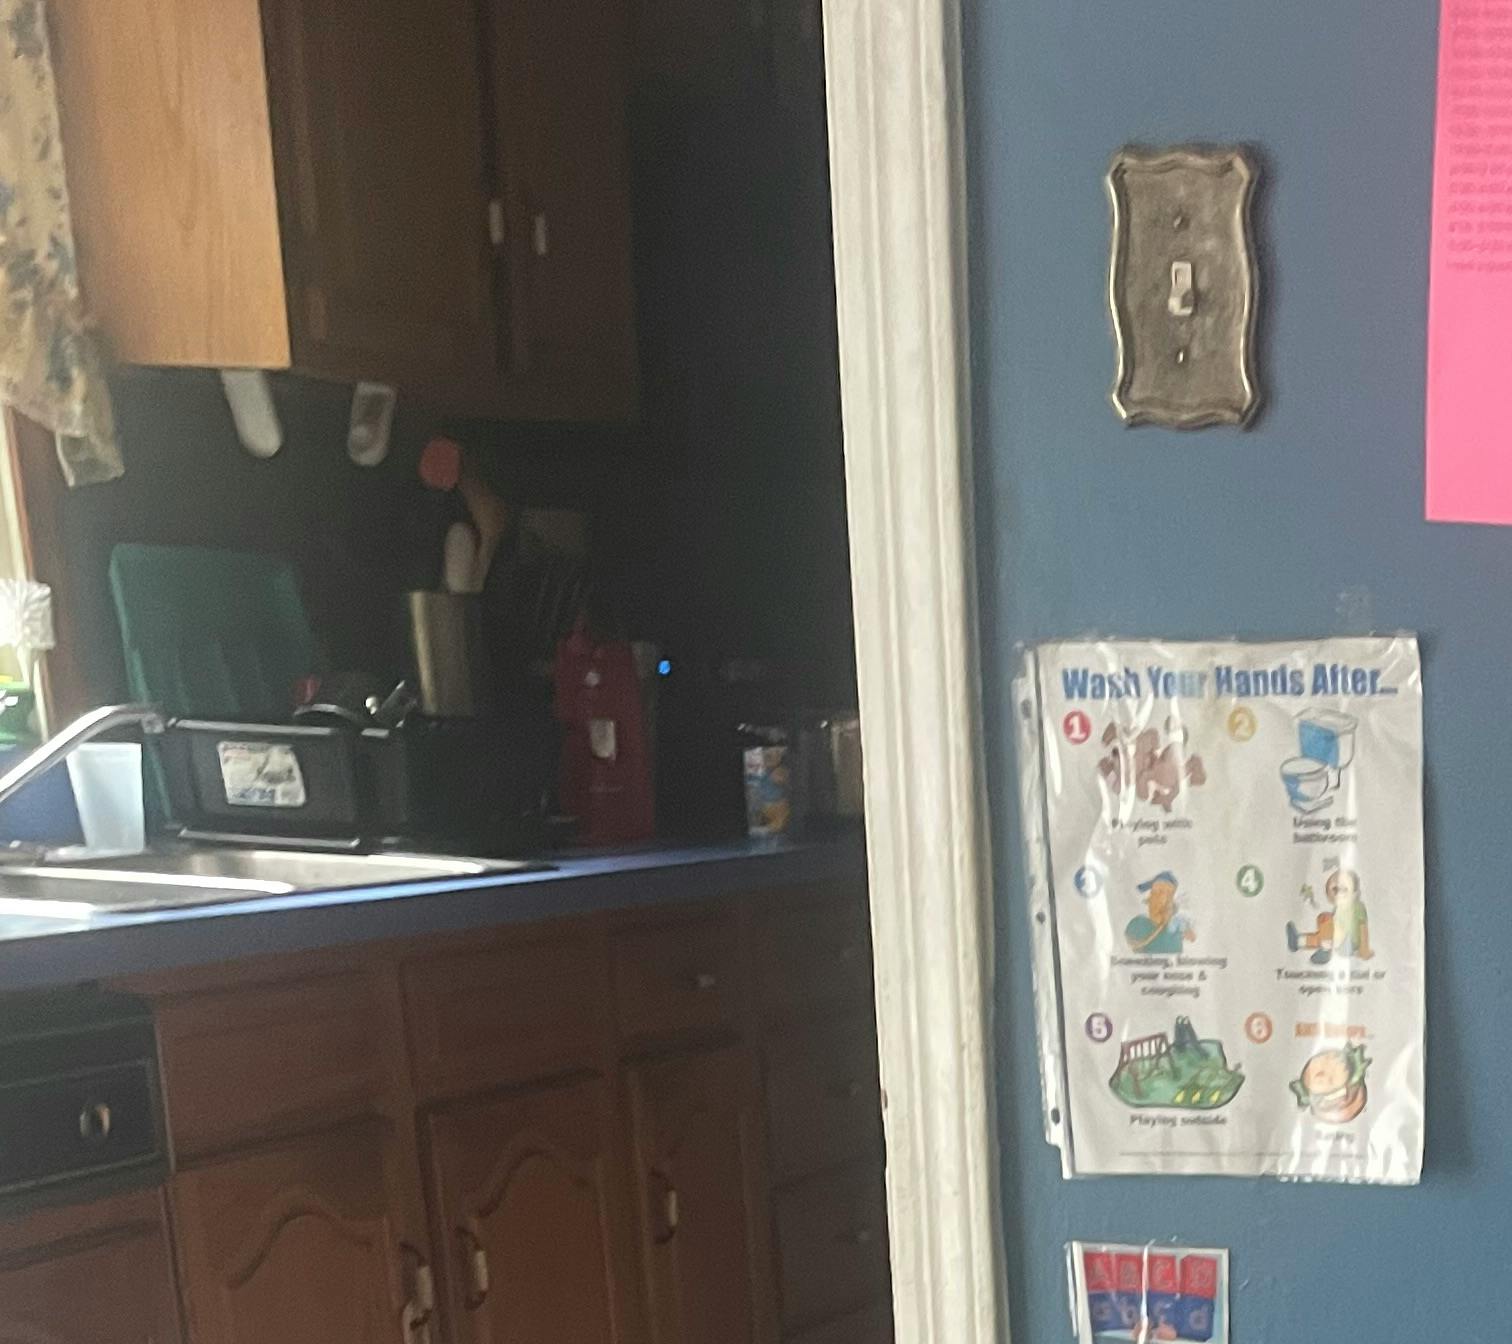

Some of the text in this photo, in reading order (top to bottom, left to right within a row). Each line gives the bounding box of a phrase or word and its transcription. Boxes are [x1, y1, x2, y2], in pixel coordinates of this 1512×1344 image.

[1062, 662, 1399, 700] Wash Your Hands After...
[1111, 818, 1159, 832] Pying
[1130, 1114, 1177, 1128] Playing
